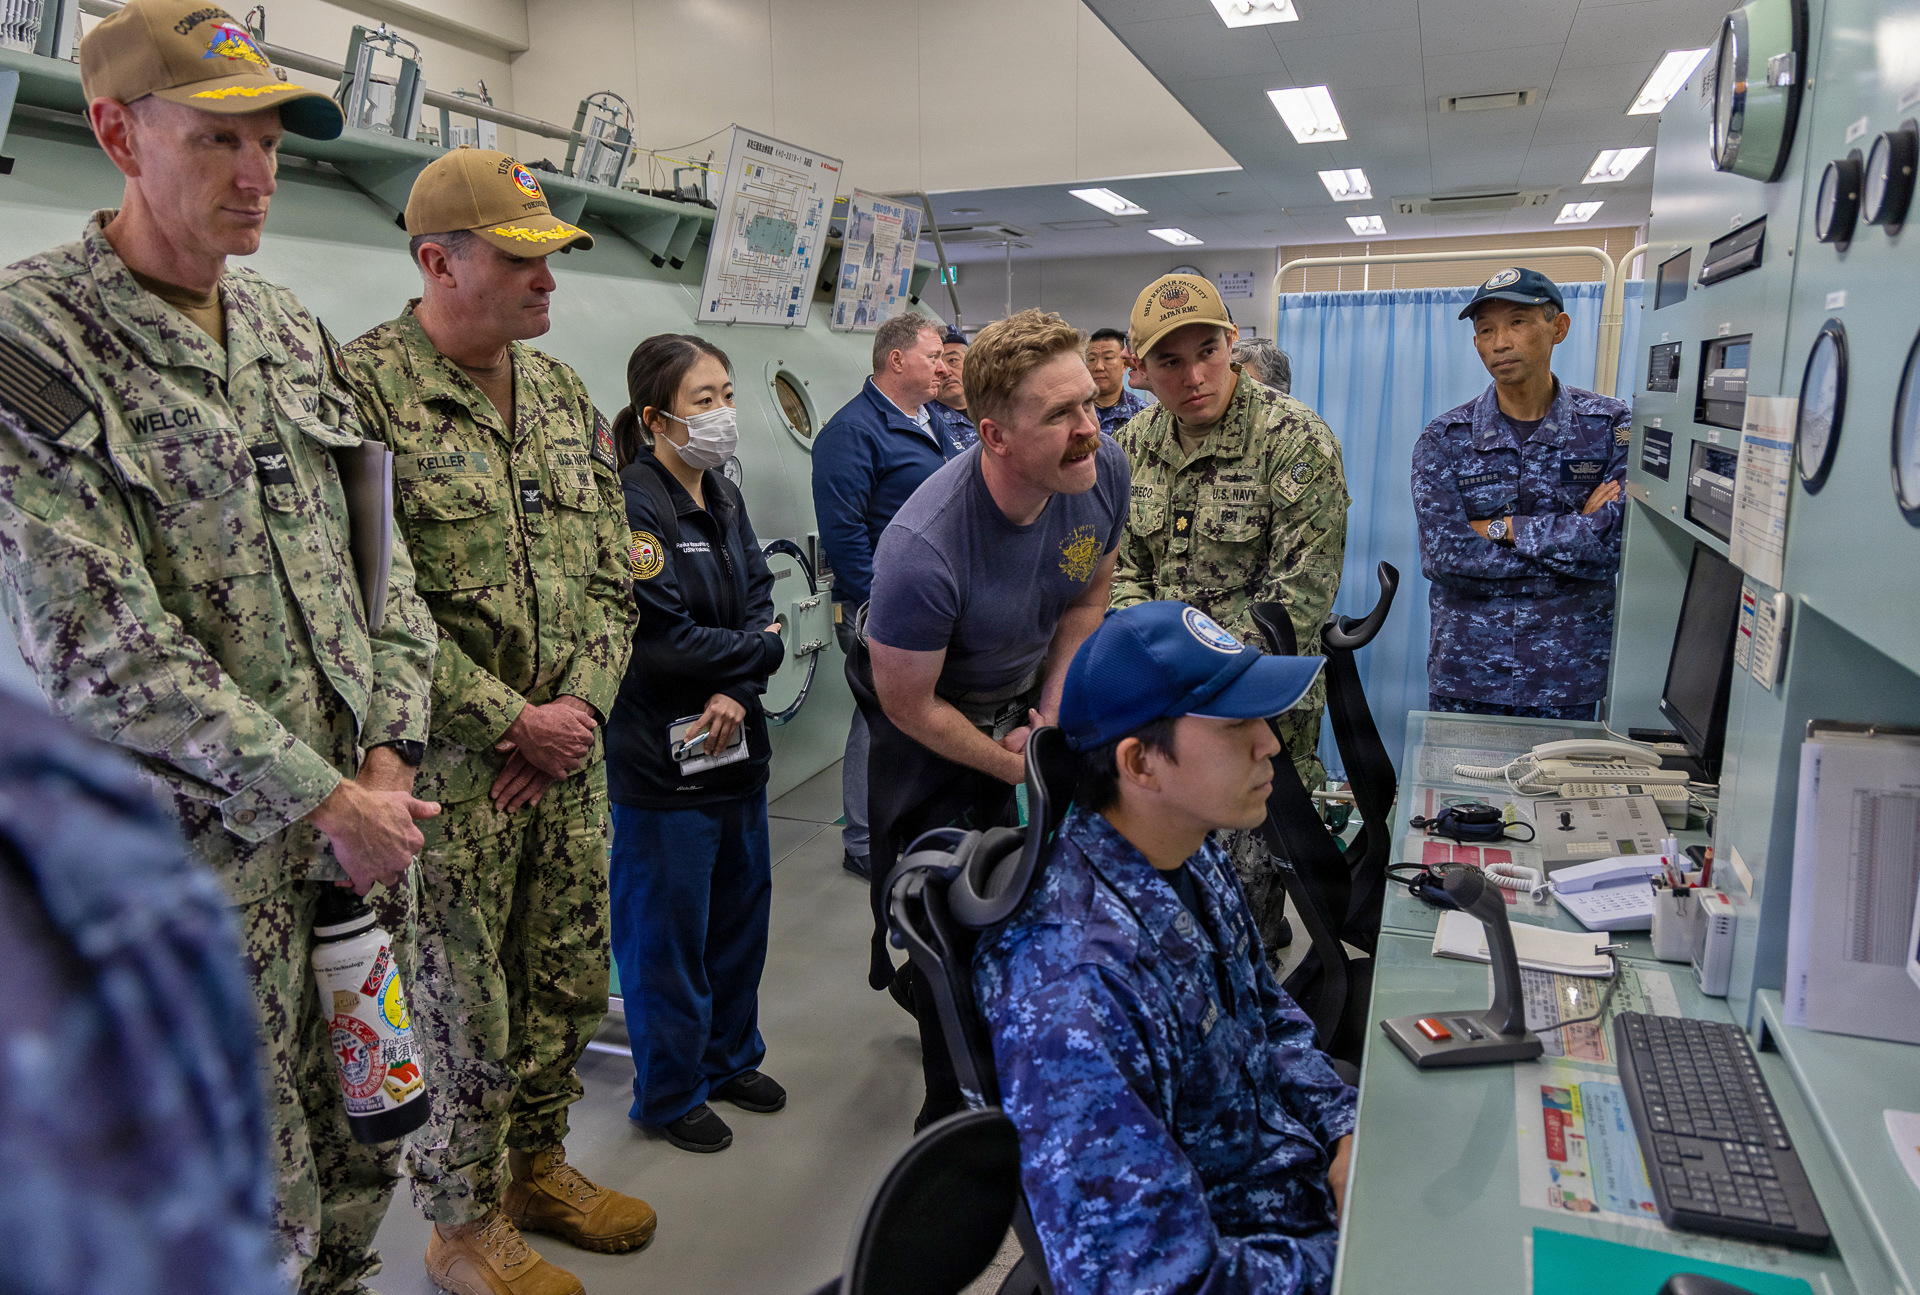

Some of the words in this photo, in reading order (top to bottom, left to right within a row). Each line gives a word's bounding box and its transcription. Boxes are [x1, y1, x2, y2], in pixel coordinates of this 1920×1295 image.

[1144, 298, 1153, 317] SHIP
[1151, 280, 1177, 298] REPAIR
[1178, 280, 1208, 299] FACILITY
[1160, 308, 1181, 322] JAPAN
[1182, 305, 1199, 314] RMC
[128, 406, 202, 435] WELCH
[416, 455, 467, 472] KELLER
[556, 453, 573, 467] U.S.
[1212, 489, 1230, 500] U.S.
[1232, 489, 1257, 501] NAVY
